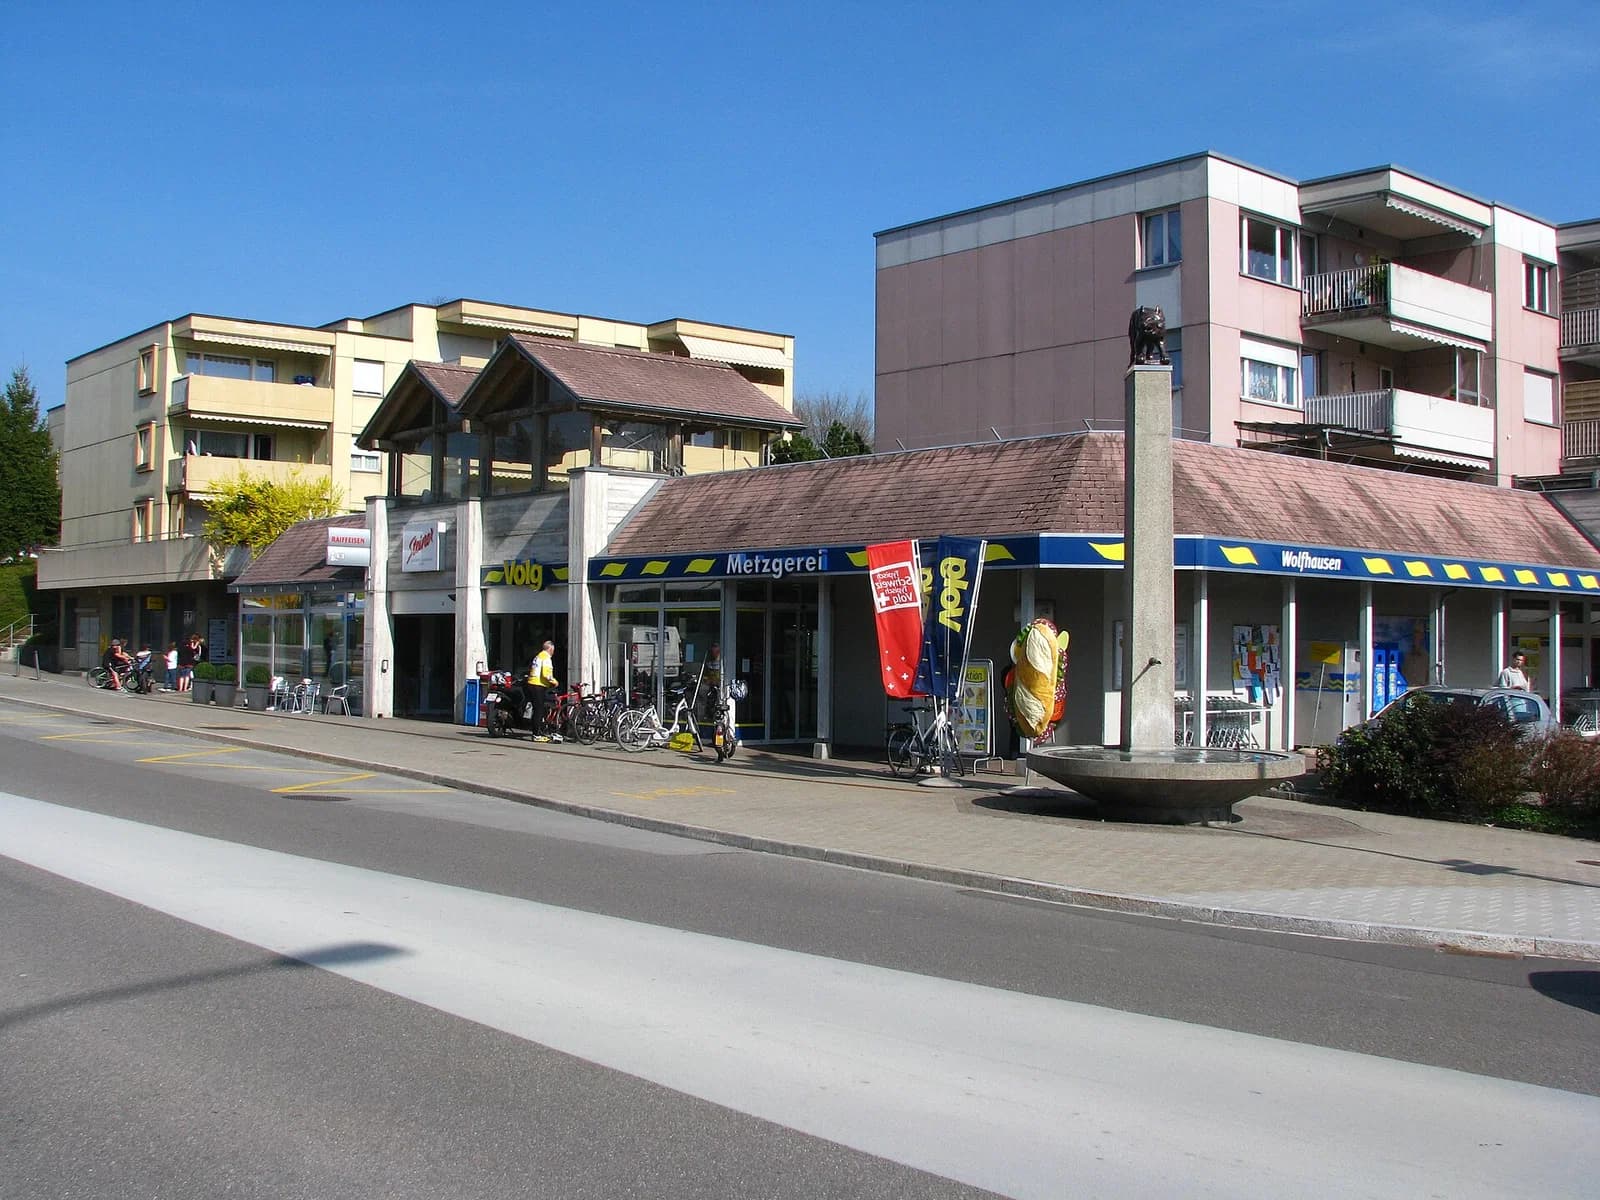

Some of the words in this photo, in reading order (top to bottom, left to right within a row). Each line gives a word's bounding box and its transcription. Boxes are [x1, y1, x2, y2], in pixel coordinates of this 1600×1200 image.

[331, 536, 365, 545] RAIFFEISEN
[726, 549, 822, 579] Metzgerei
[1281, 550, 1342, 573] Wolfhausen
[503, 559, 543, 592] Volg
